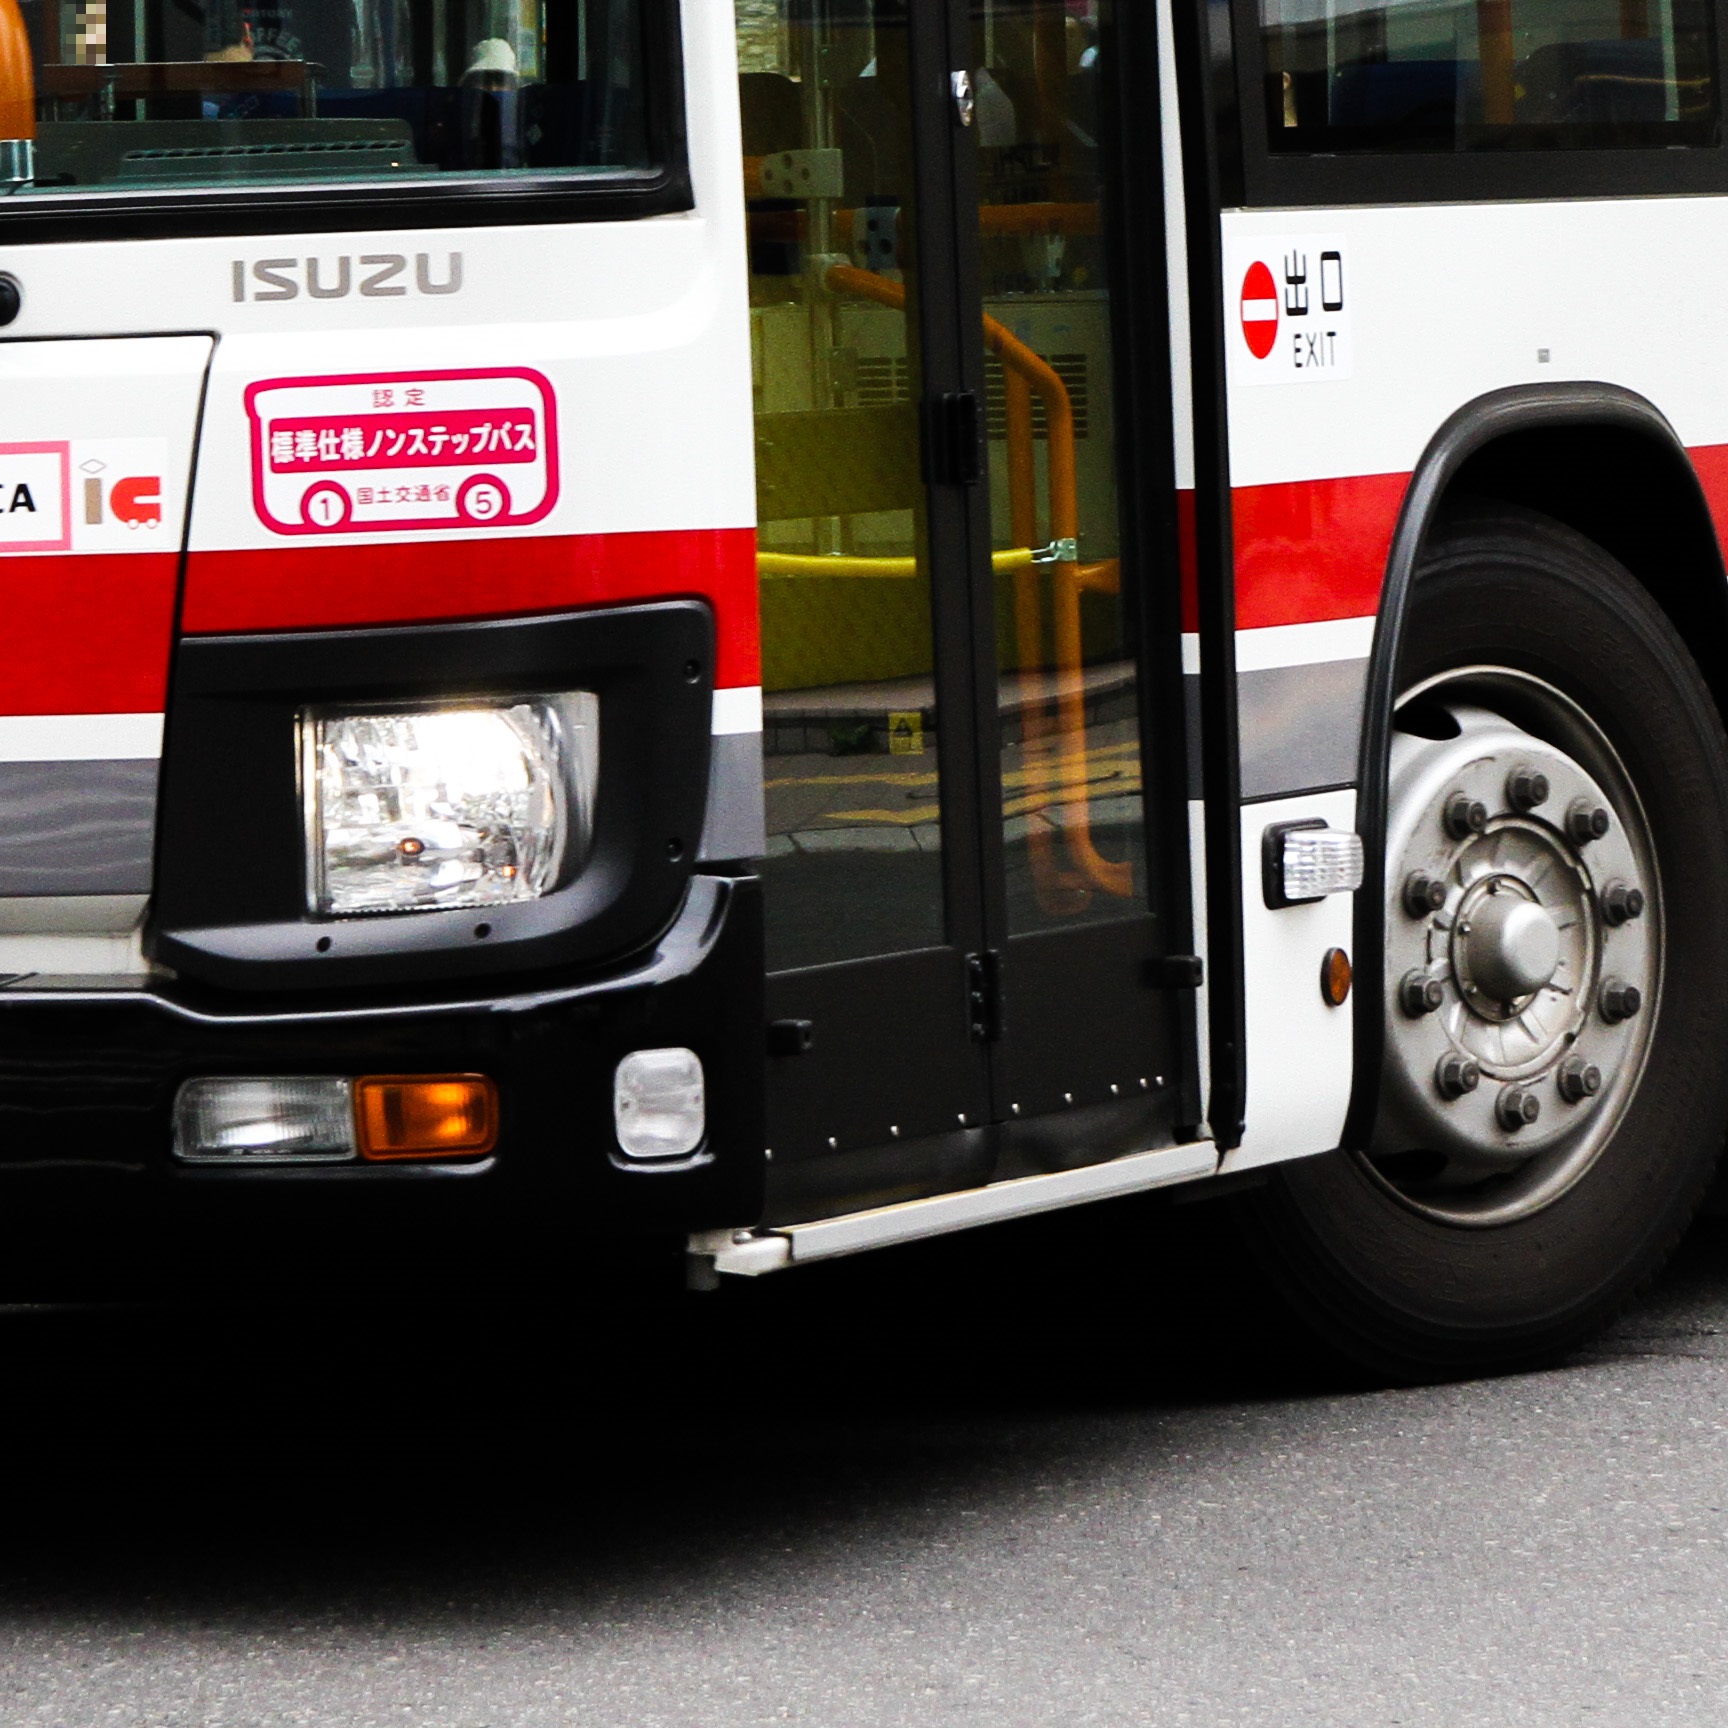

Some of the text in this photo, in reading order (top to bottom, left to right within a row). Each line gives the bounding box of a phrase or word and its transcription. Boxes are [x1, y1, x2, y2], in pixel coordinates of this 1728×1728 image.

[232, 253, 463, 303] ISUZU
[1283, 249, 1344, 317] 出口
[1294, 332, 1338, 370] EXIT
[271, 422, 536, 465] 標準仕様ノンステップバス
[357, 484, 451, 505] 国土交通省
[475, 490, 493, 515] 5
